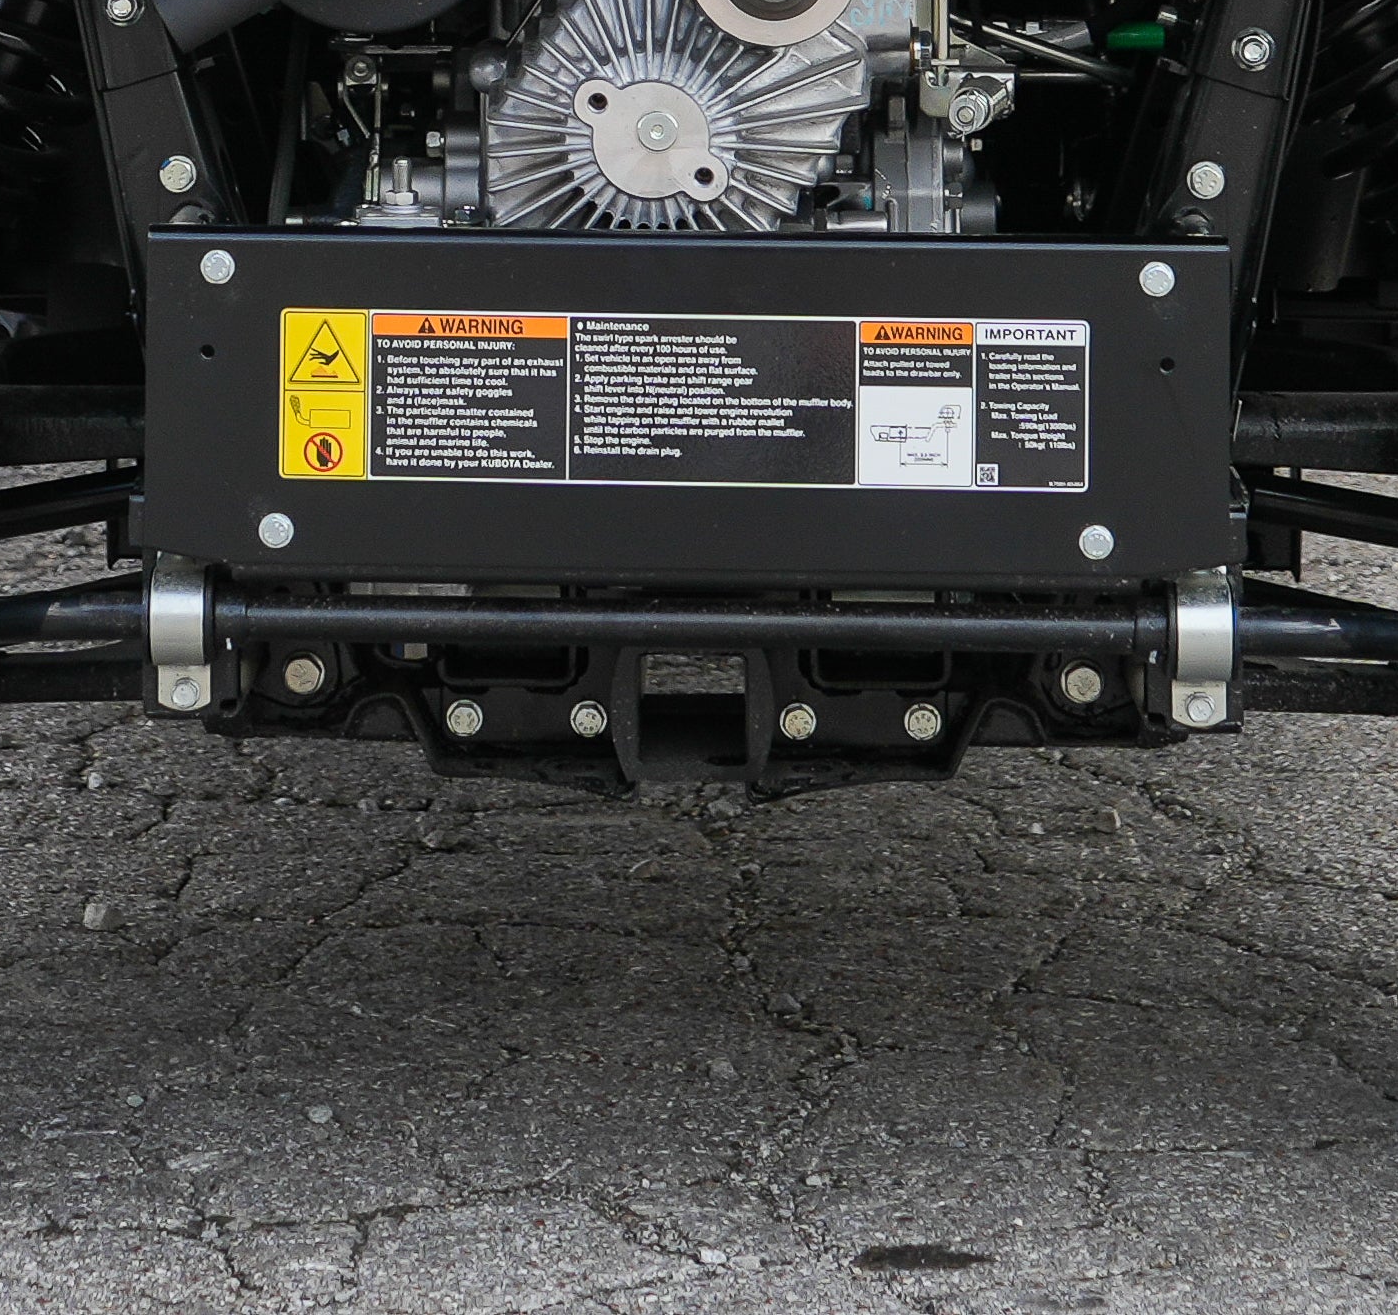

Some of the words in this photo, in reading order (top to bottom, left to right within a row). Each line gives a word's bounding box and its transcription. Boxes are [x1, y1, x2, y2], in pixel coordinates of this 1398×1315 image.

[440, 319, 524, 335] WARNING
[890, 326, 963, 340] WARNING
[985, 328, 1077, 341] IMPORTANT
[377, 339, 390, 348] TO
[392, 340, 421, 348] AVOID
[423, 340, 476, 349] PERSONAL
[387, 355, 418, 363] Before
[419, 356, 460, 366] touching
[462, 358, 479, 366] any
[481, 357, 499, 366] part
[501, 357, 511, 365] of
[526, 358, 563, 366] exhaust
[425, 366, 437, 374] be
[438, 367, 486, 376] absolutely
[511, 368, 529, 376] that
[531, 368, 537, 376] it
[539, 368, 556, 376] has
[387, 376, 404, 384] had
[406, 376, 449, 384] sufficient
[451, 377, 472, 385] time
[473, 377, 483, 385] to
[386, 386, 420, 395] Always
[445, 387, 474, 397] safety
[475, 388, 512, 397] goggles
[386, 396, 404, 404] and
[387, 406, 404, 414] The
[406, 407, 455, 415] particulate
[457, 408, 486, 416] matter
[488, 408, 533, 417] contained
[386, 416, 395, 424] in
[397, 417, 413, 425] the
[414, 417, 447, 425] muffler
[449, 418, 489, 426] contains
[491, 419, 537, 427] chemicals
[386, 427, 404, 435] that
[423, 427, 459, 435] harmful
[460, 428, 470, 436] to
[386, 437, 417, 445] animal
[418, 438, 436, 446] and
[386, 447, 393, 455] If
[395, 449, 412, 457] you
[431, 448, 462, 456] unable
[464, 449, 474, 457] to
[476, 449, 488, 457] do
[490, 449, 507, 457] this
[386, 458, 408, 466] have
[410, 458, 417, 466] it
[418, 458, 442, 466] done
[444, 458, 455, 468] by
[457, 460, 479, 469] your
[481, 459, 521, 467] KUBOTA
